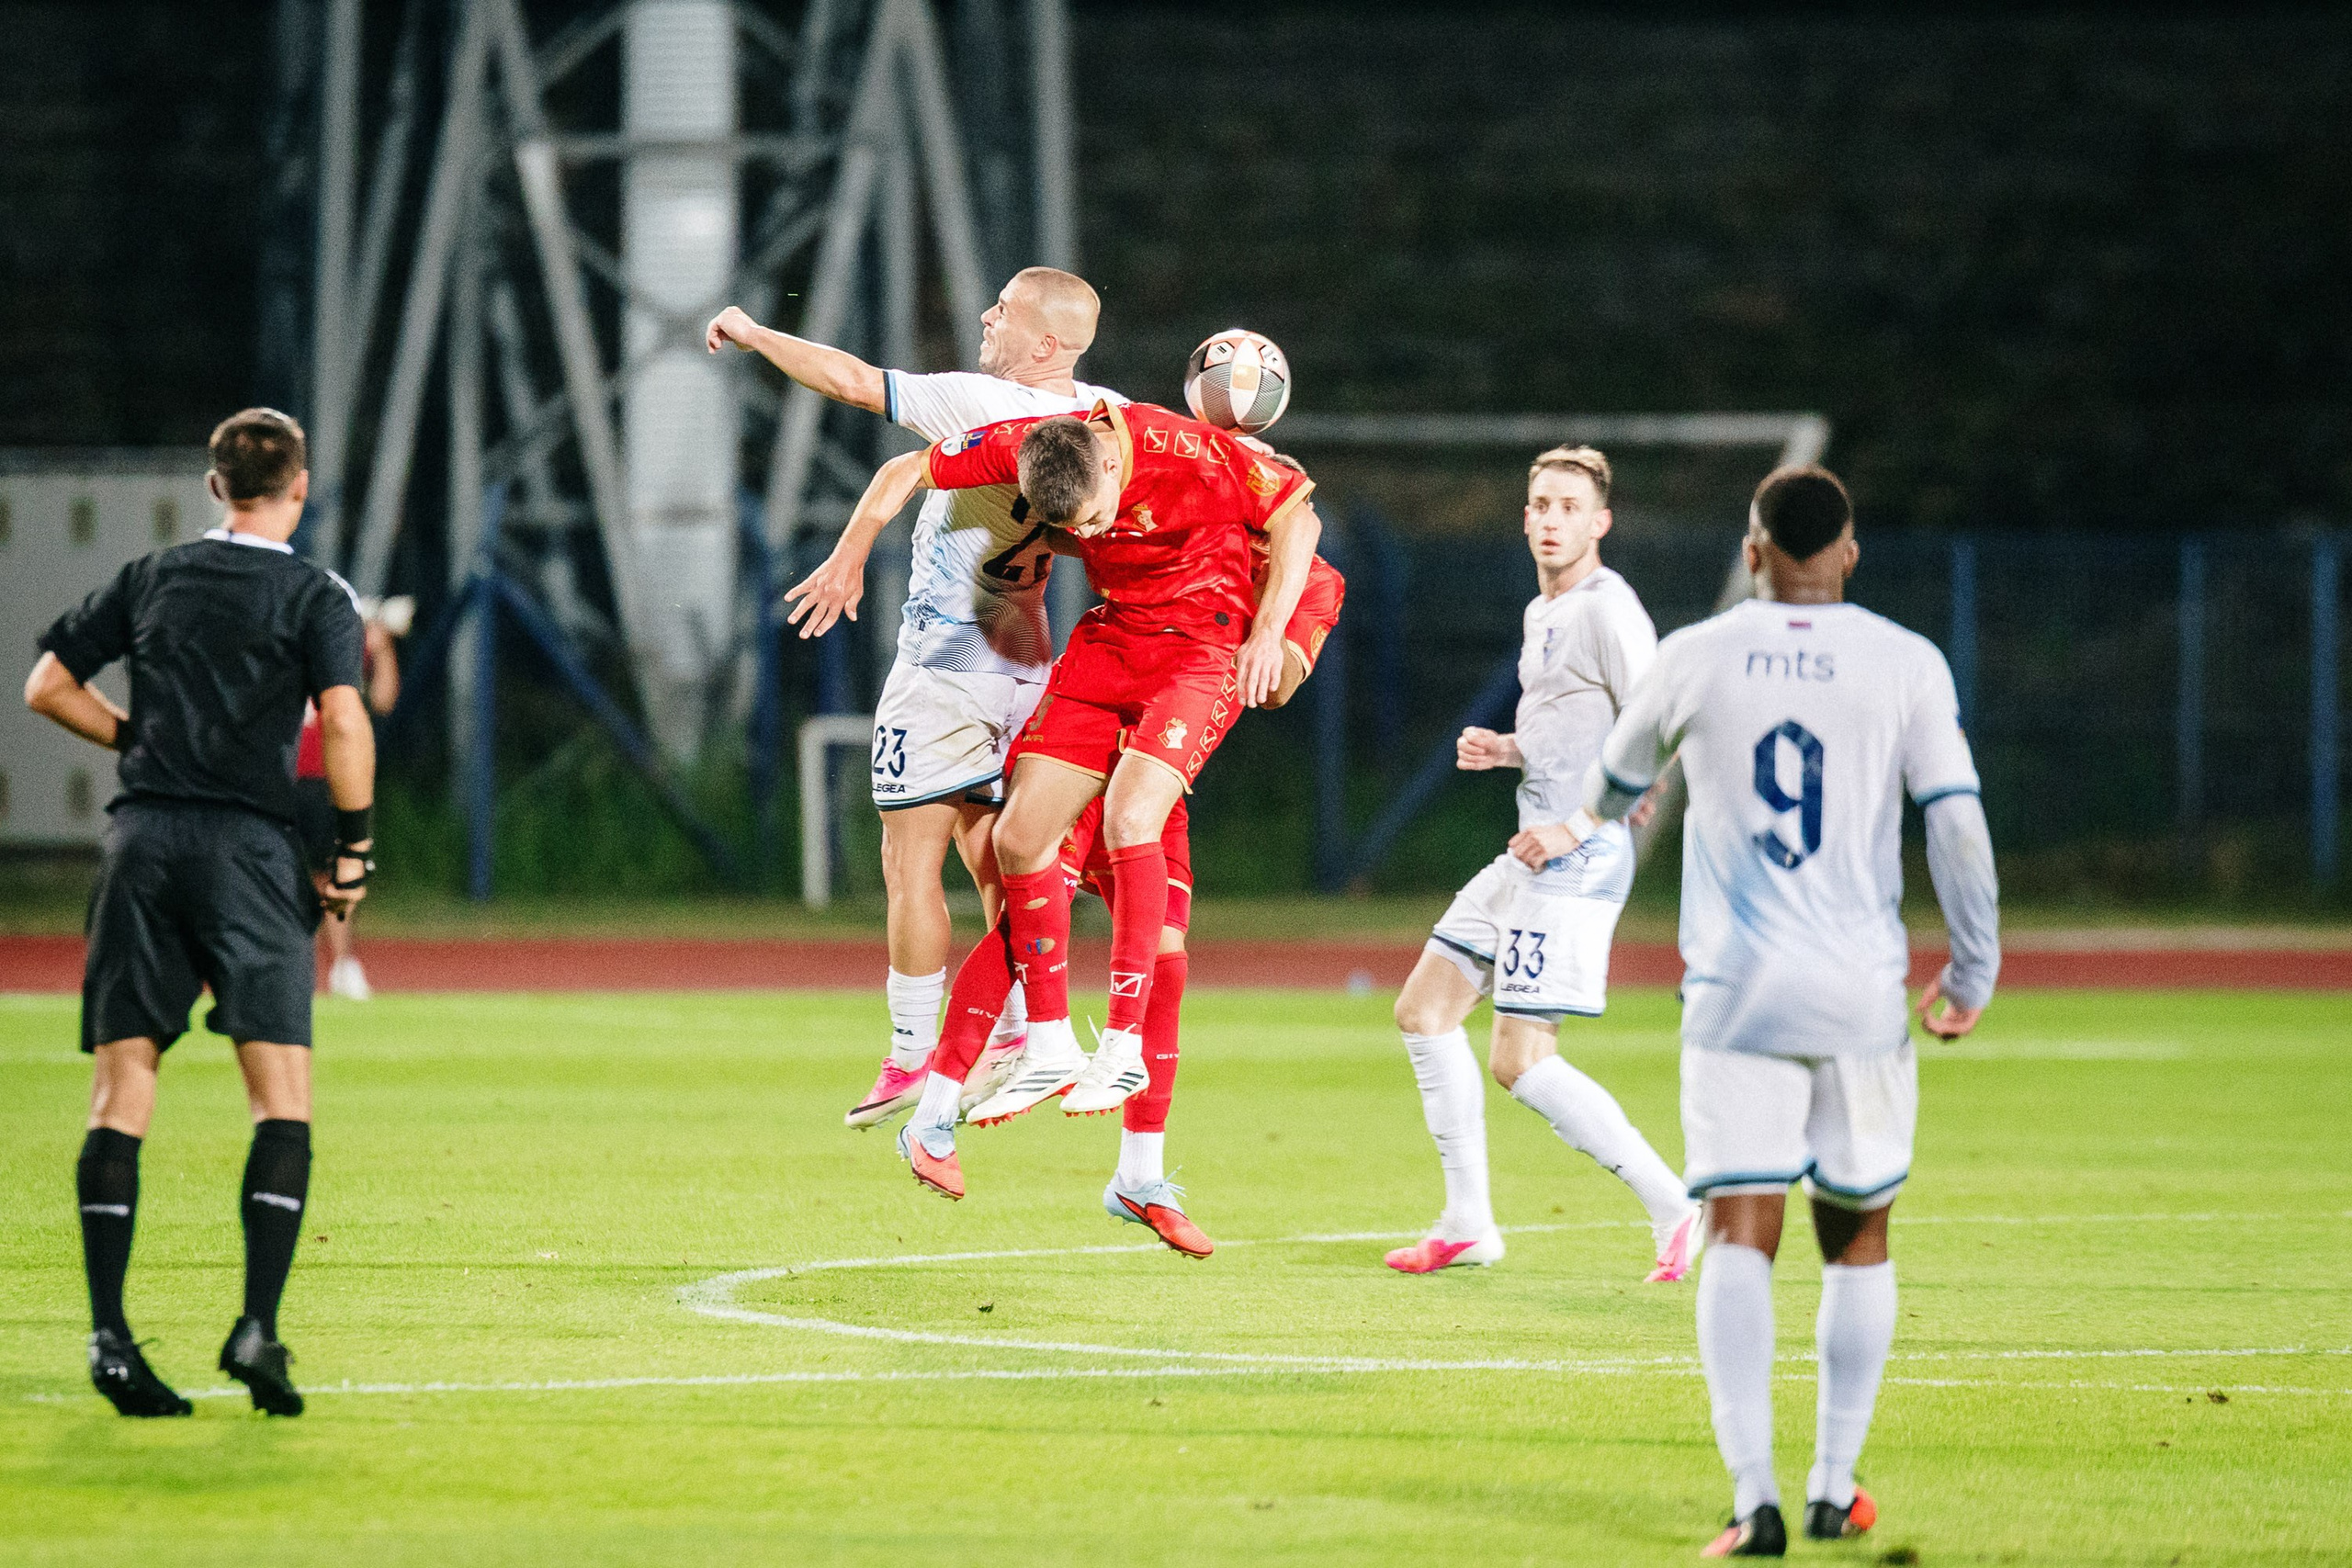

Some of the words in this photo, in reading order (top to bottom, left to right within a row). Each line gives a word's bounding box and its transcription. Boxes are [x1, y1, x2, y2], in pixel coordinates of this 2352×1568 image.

[1747, 649, 1835, 682] mts
[874, 725, 907, 778] 23
[1752, 719, 1824, 869] 9
[1503, 929, 1546, 979] 33
[1500, 982, 1540, 993] LEGEA
